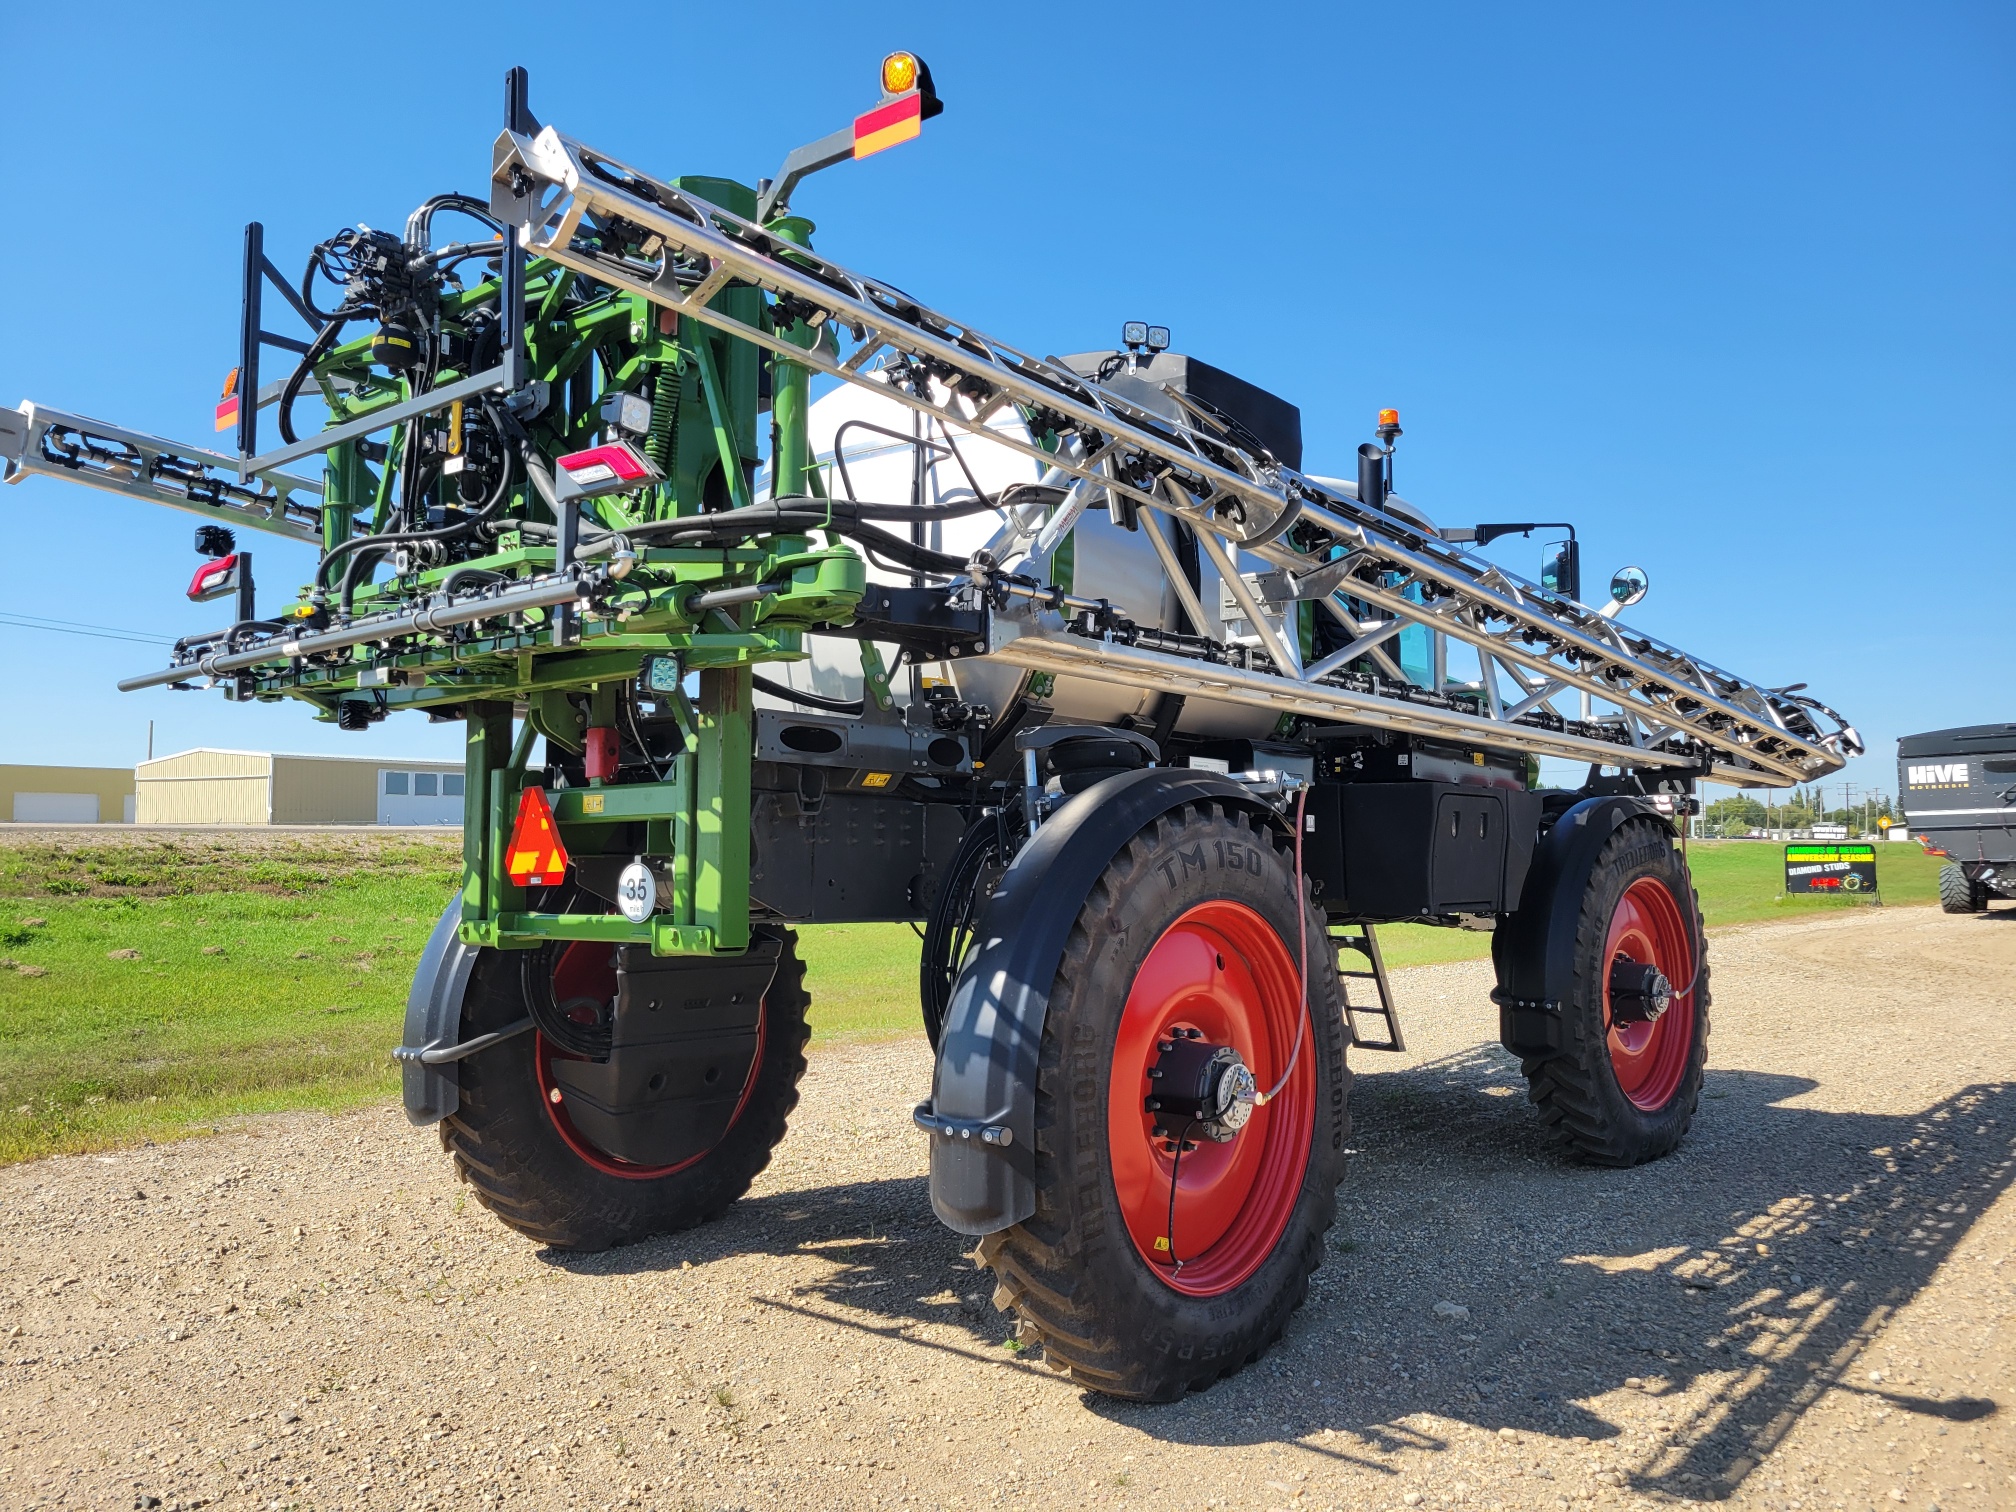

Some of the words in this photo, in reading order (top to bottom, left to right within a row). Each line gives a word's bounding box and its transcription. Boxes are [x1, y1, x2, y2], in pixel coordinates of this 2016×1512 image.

[1156, 842, 1207, 890] TM
[1212, 838, 1262, 877] 150
[1612, 841, 1666, 877] TRELLEBORG
[1788, 865, 1822, 875] DIAMOND
[1824, 862, 1850, 871] STUDS
[626, 878, 647, 901] 35
[1322, 963, 1343, 1150] TRELLEBORG
